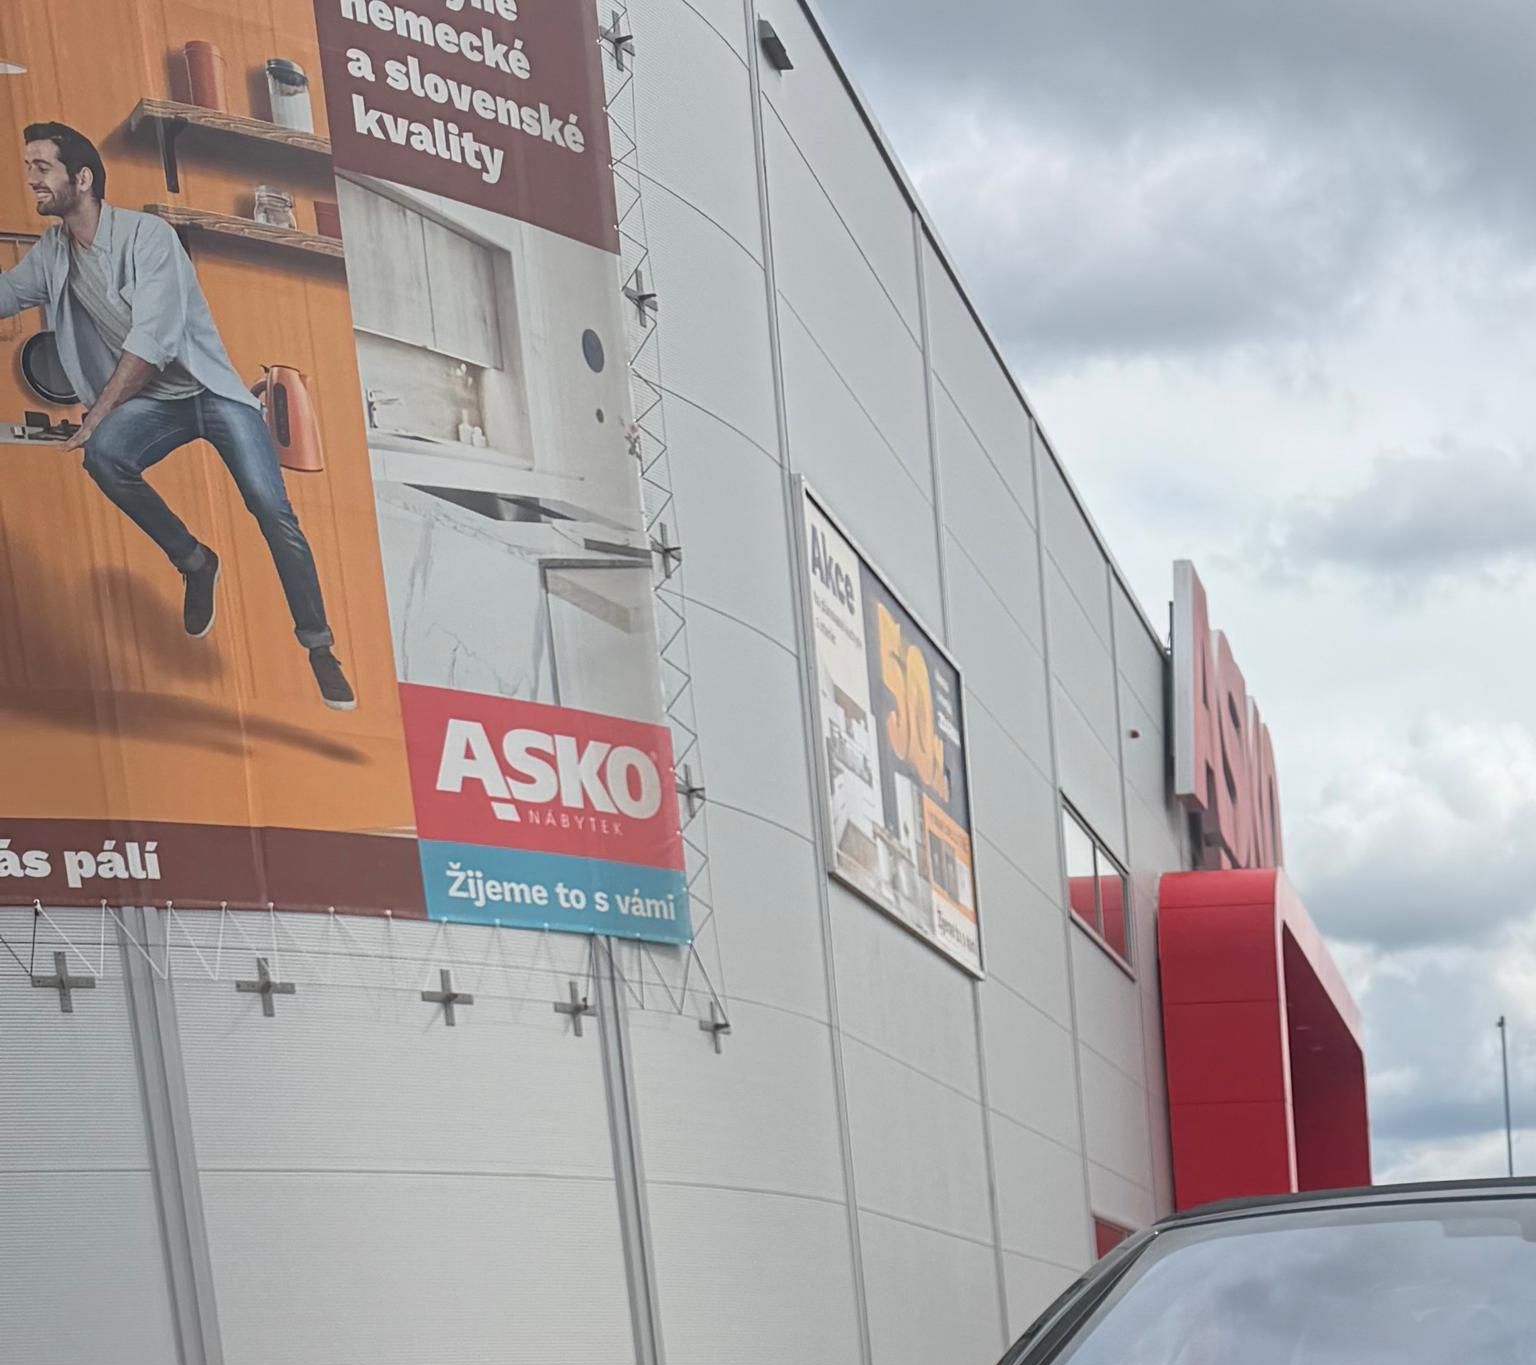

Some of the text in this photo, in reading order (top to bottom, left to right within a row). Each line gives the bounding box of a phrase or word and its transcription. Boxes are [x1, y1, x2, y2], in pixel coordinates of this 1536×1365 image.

[346, 48, 585, 153] a slovenské
[351, 93, 504, 184] kvality
[436, 718, 662, 822] ASKO
[64, 839, 161, 889] pálí
[446, 861, 676, 921] Žijeme to s vámi
